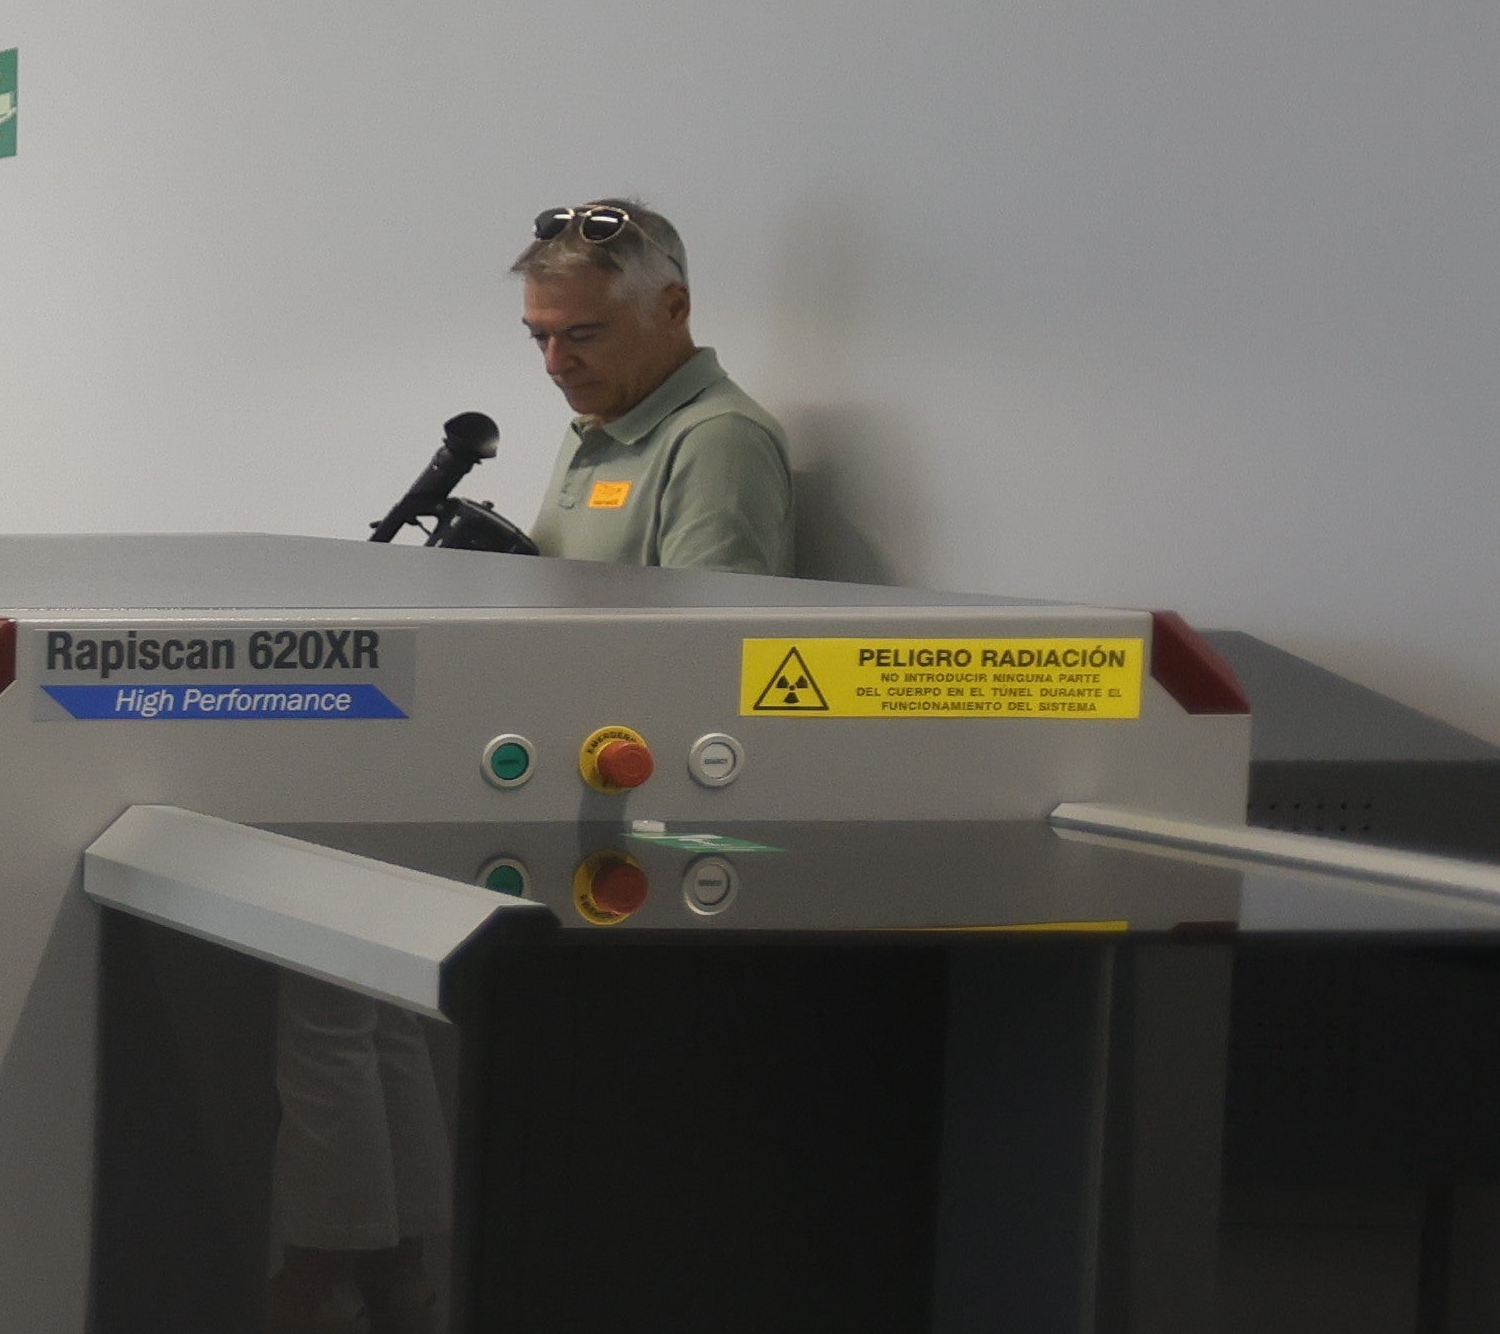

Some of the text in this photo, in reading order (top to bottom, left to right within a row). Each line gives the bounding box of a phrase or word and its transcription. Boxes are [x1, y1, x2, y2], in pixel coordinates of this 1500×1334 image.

[46, 629, 380, 679] Rapiscan 620XR
[858, 644, 1126, 668] PELIGRO RADIACIÓN
[880, 672, 1100, 683] NO INTRODUCIR NINGUNA PARTE
[855, 685, 1123, 698] DEL CUERPO EN EL TÚNEL DURANTE EL
[114, 688, 352, 717] High Performance
[881, 701, 1097, 713] FUNCIONAMIENTO DEL SISTEMA
